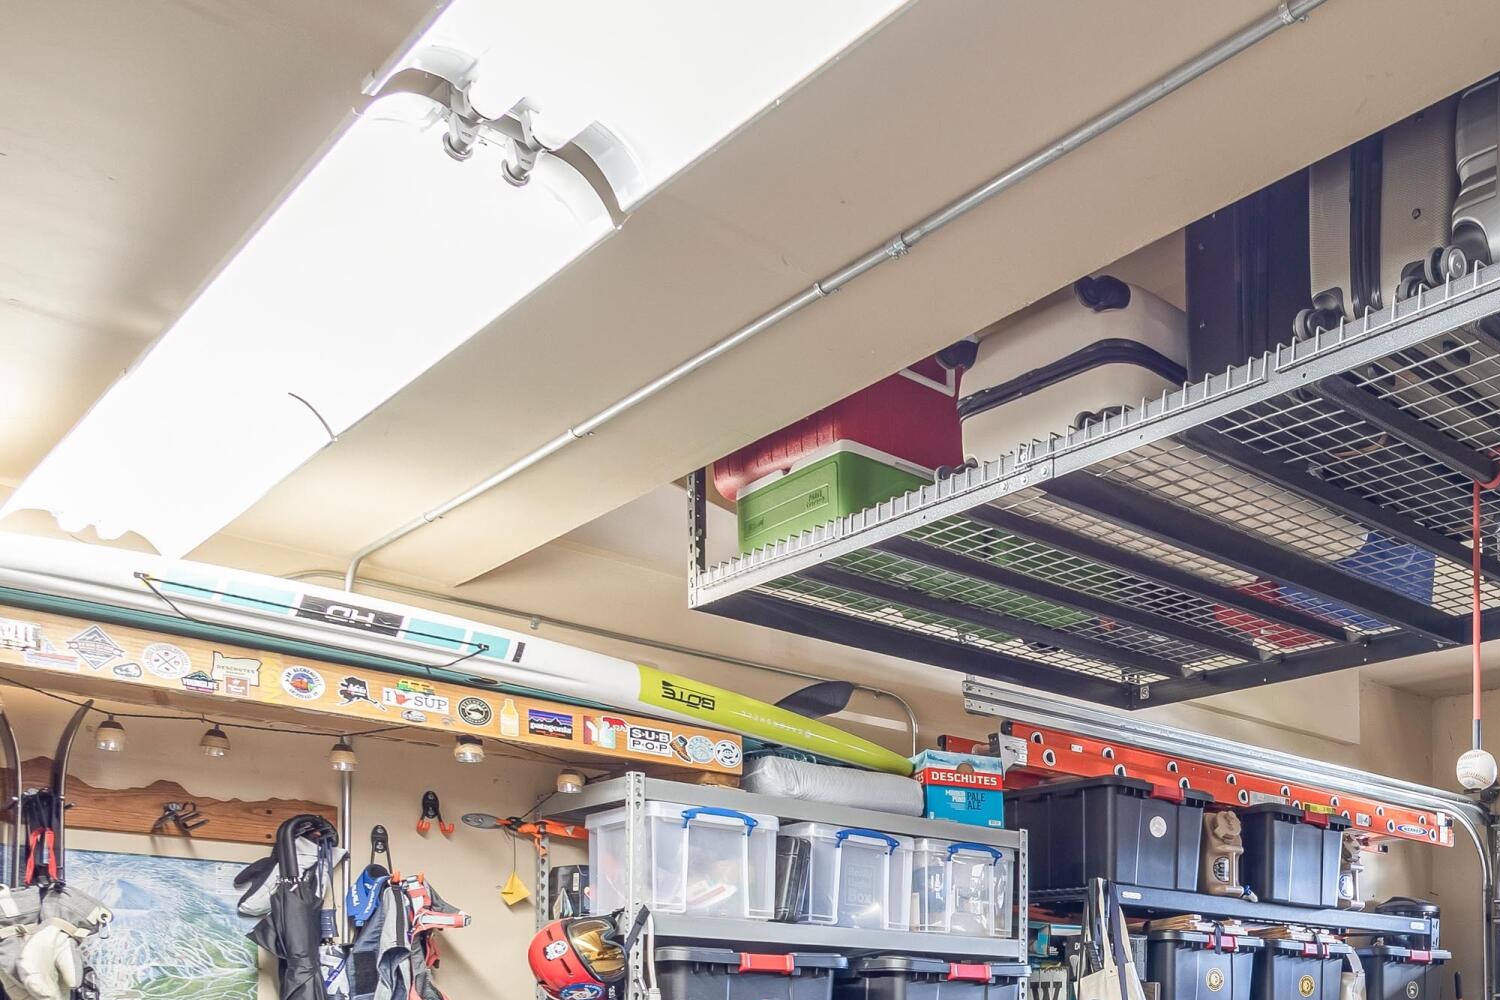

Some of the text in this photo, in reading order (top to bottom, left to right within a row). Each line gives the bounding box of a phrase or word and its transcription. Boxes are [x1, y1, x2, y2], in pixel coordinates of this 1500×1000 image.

[385, 691, 448, 711] I SUP
[662, 686, 715, 711] BOTE
[530, 722, 572, 734] patagonia
[931, 771, 998, 786] DESCHUTES
[966, 791, 985, 802] PALE
[967, 801, 982, 811] ALE
